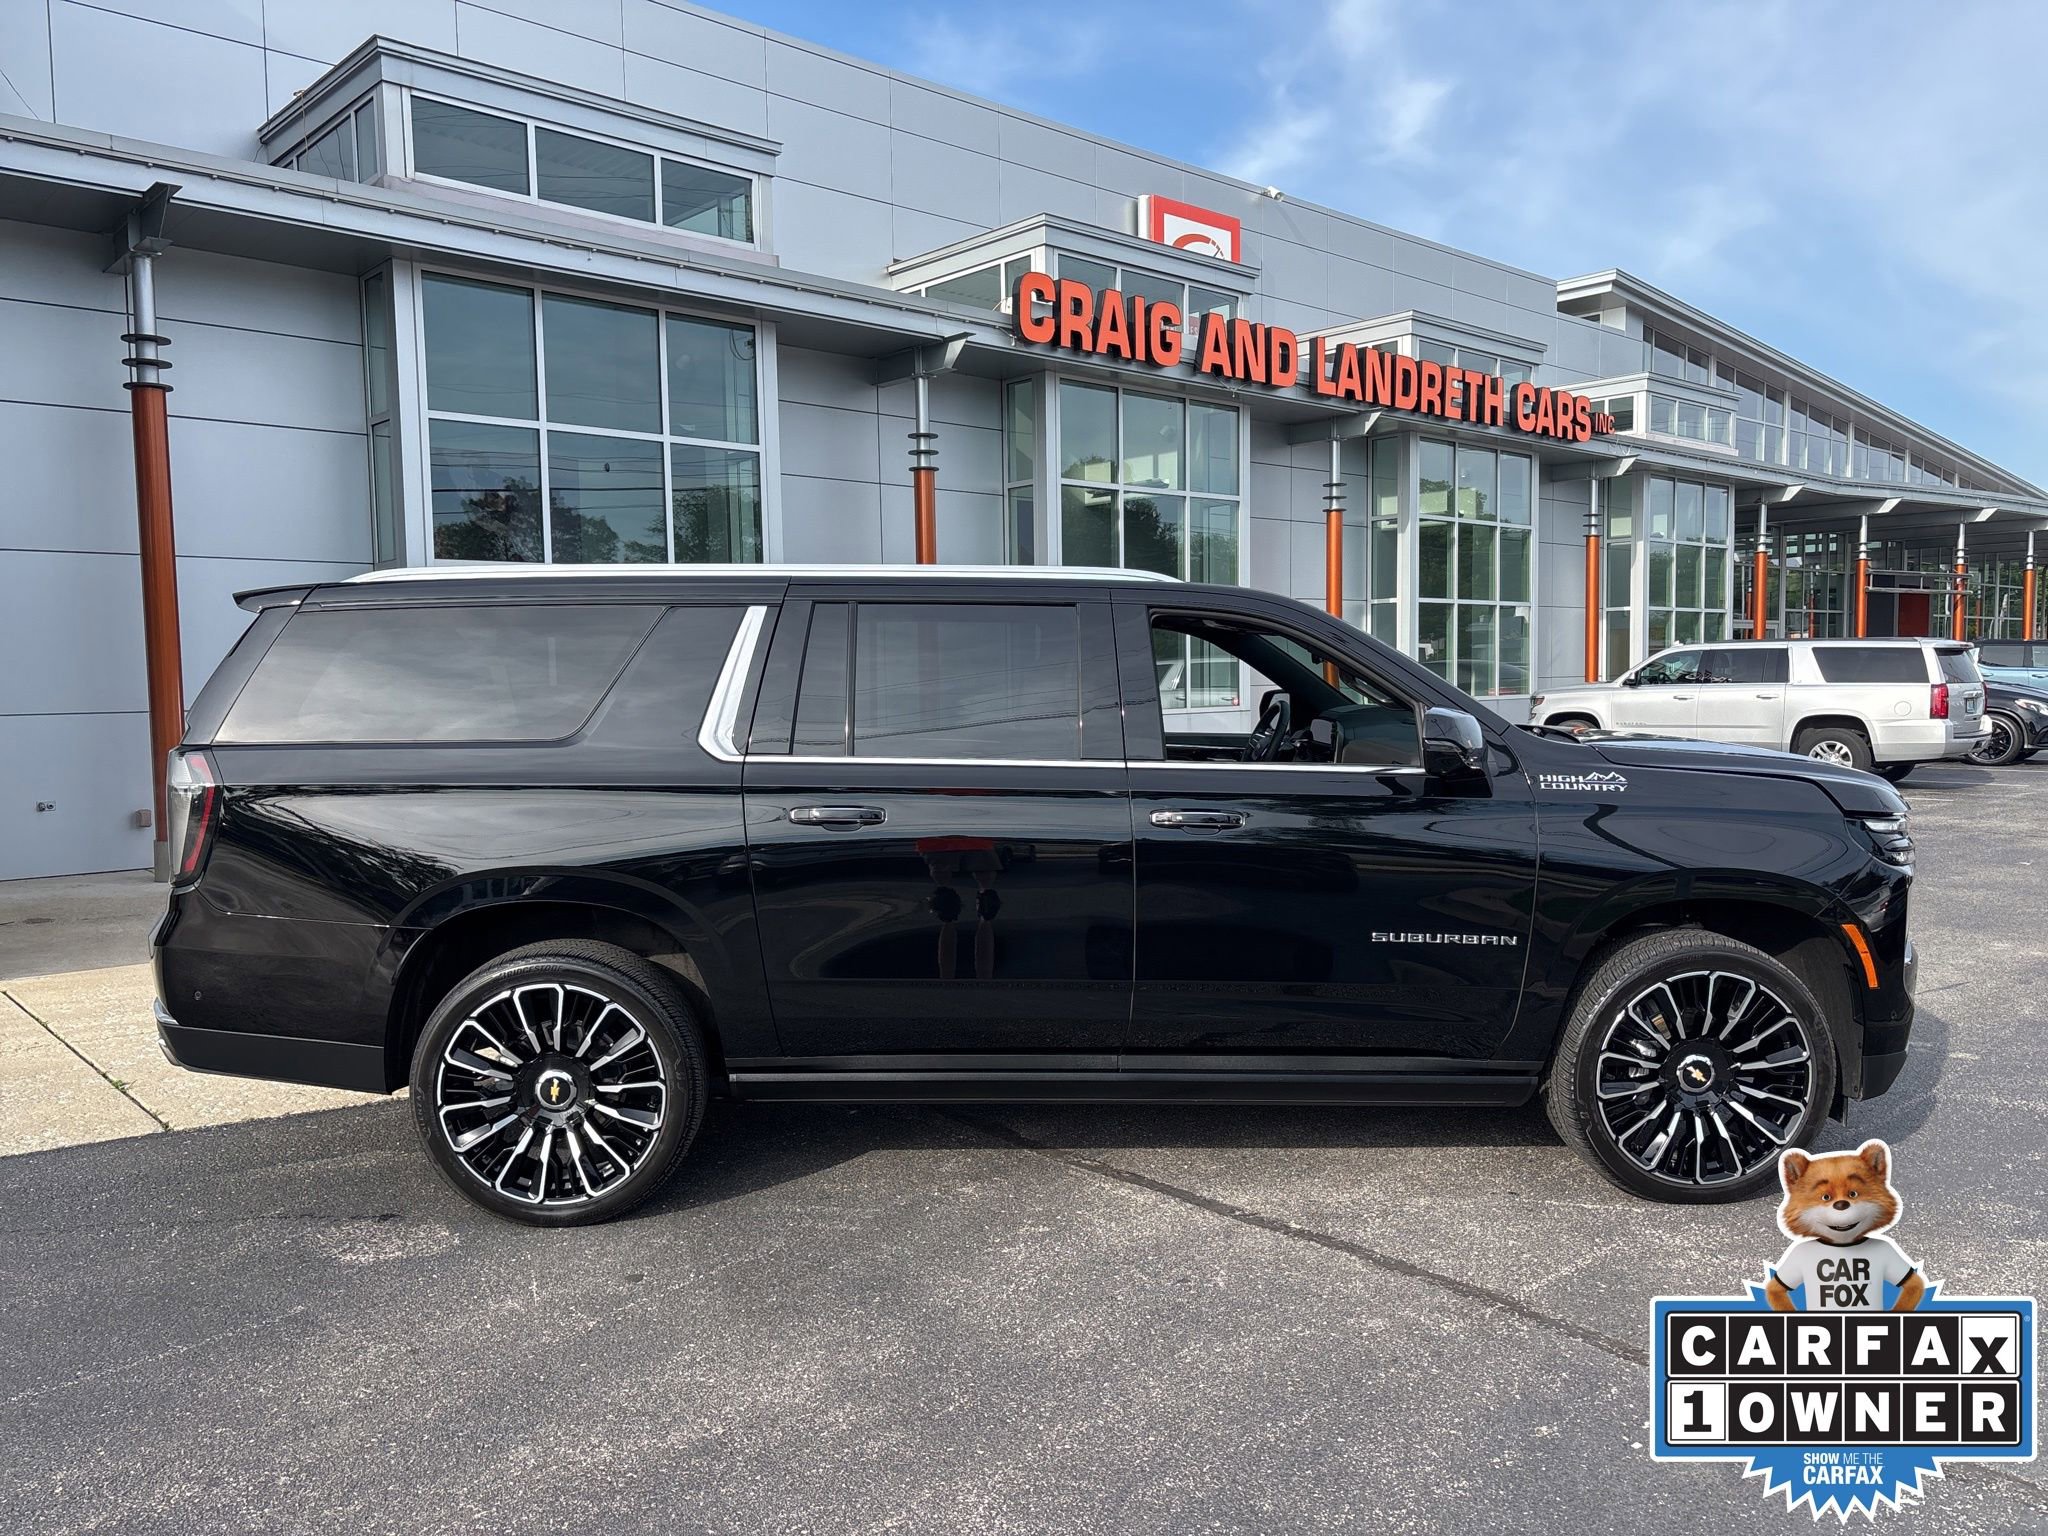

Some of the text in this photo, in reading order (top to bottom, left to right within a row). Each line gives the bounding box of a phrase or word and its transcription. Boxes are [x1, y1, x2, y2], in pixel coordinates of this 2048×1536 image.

[1016, 271, 1616, 442] CRAIG AND LANDRETH CARS INC
[1539, 774, 1585, 783] HIGH
[1540, 782, 1628, 792] COUNTRY
[1371, 931, 1518, 946] SUBURBAN
